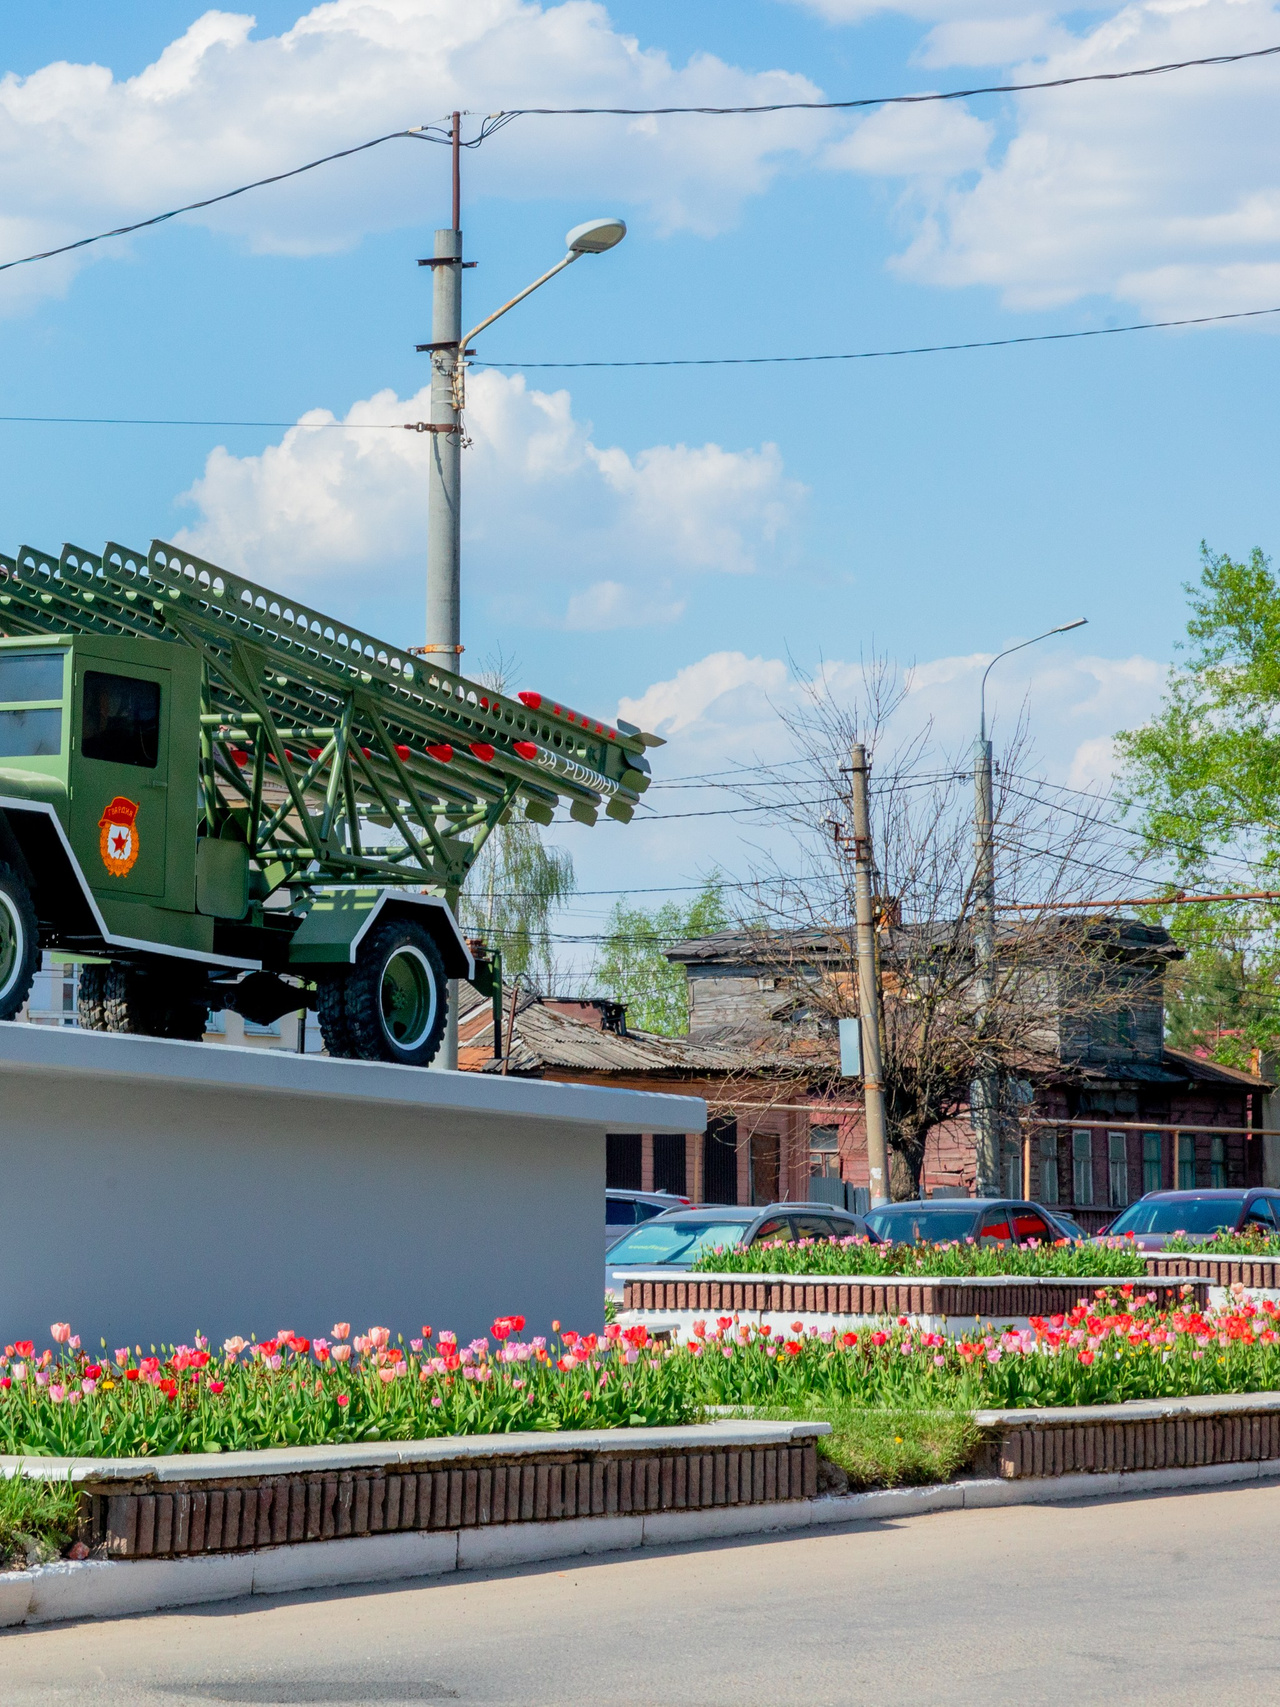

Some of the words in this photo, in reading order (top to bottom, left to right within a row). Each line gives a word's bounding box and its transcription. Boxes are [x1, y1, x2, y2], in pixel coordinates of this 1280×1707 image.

[537, 748, 558, 770] ЗА
[562, 758, 620, 796] РОДИНУ
[108, 806, 133, 818] ГВАРДИЯ
